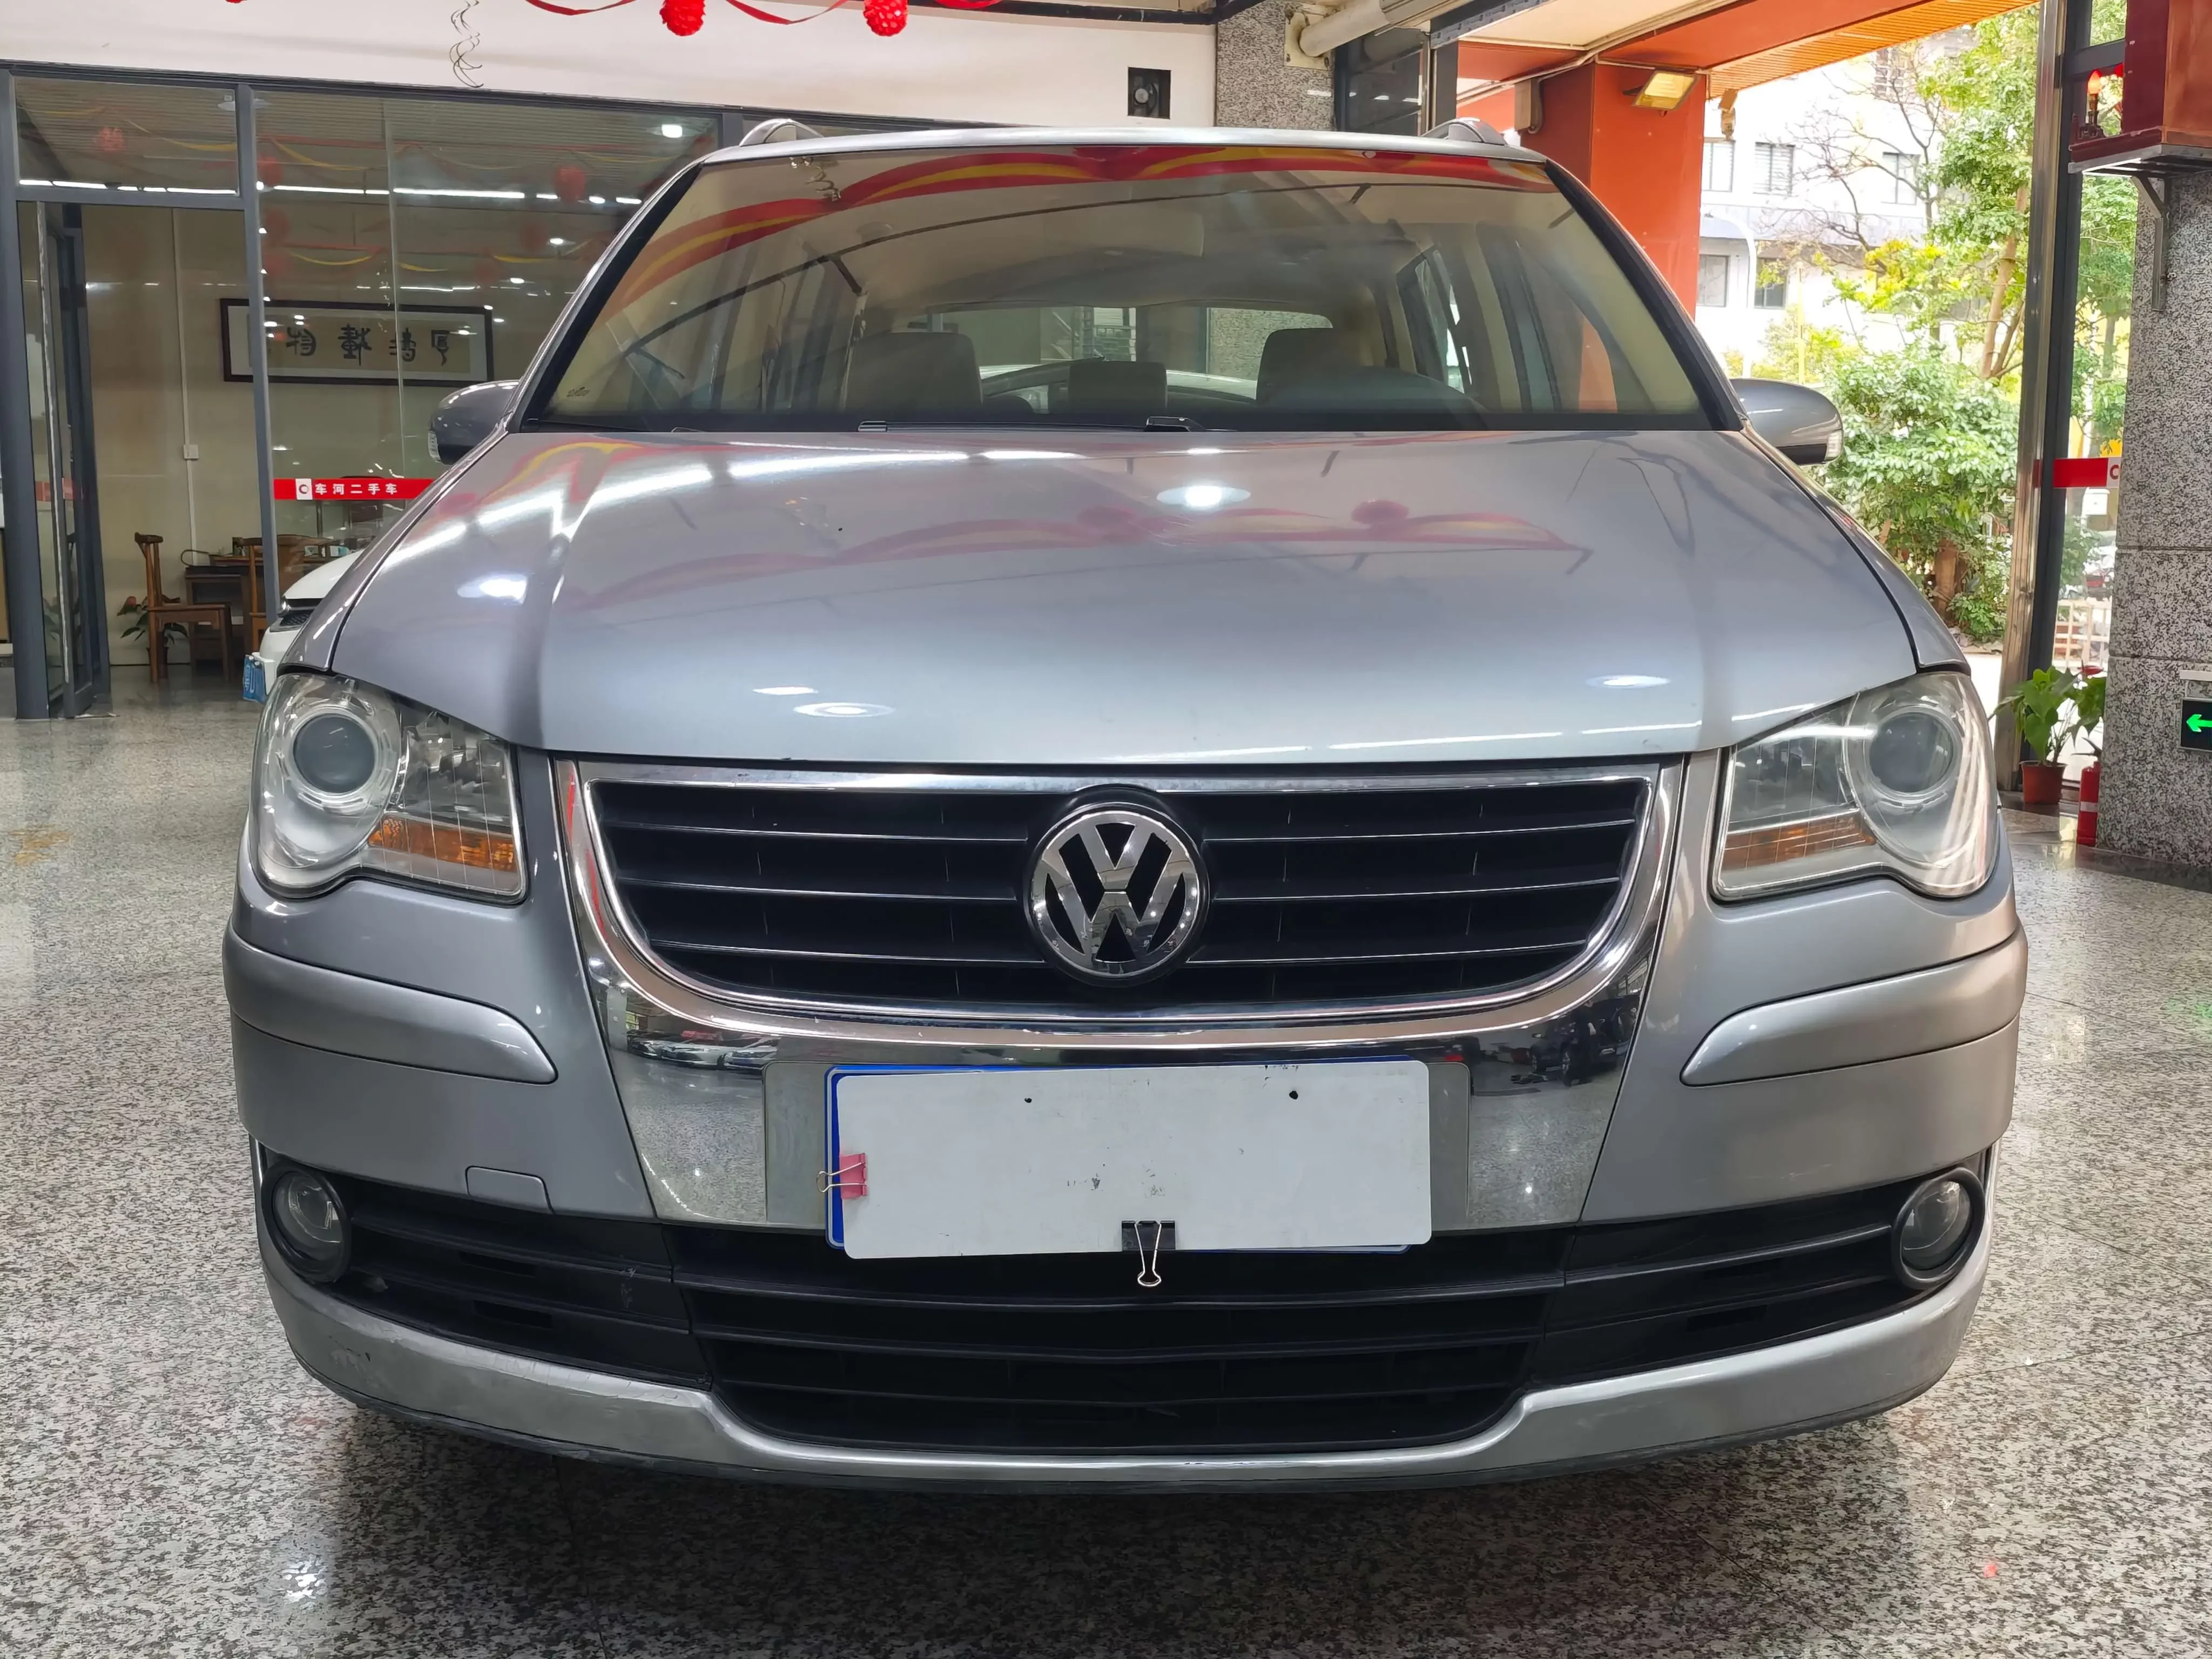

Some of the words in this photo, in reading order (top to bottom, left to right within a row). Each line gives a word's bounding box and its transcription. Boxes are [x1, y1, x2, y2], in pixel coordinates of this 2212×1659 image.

[315, 483, 397, 495] 车河二手车
